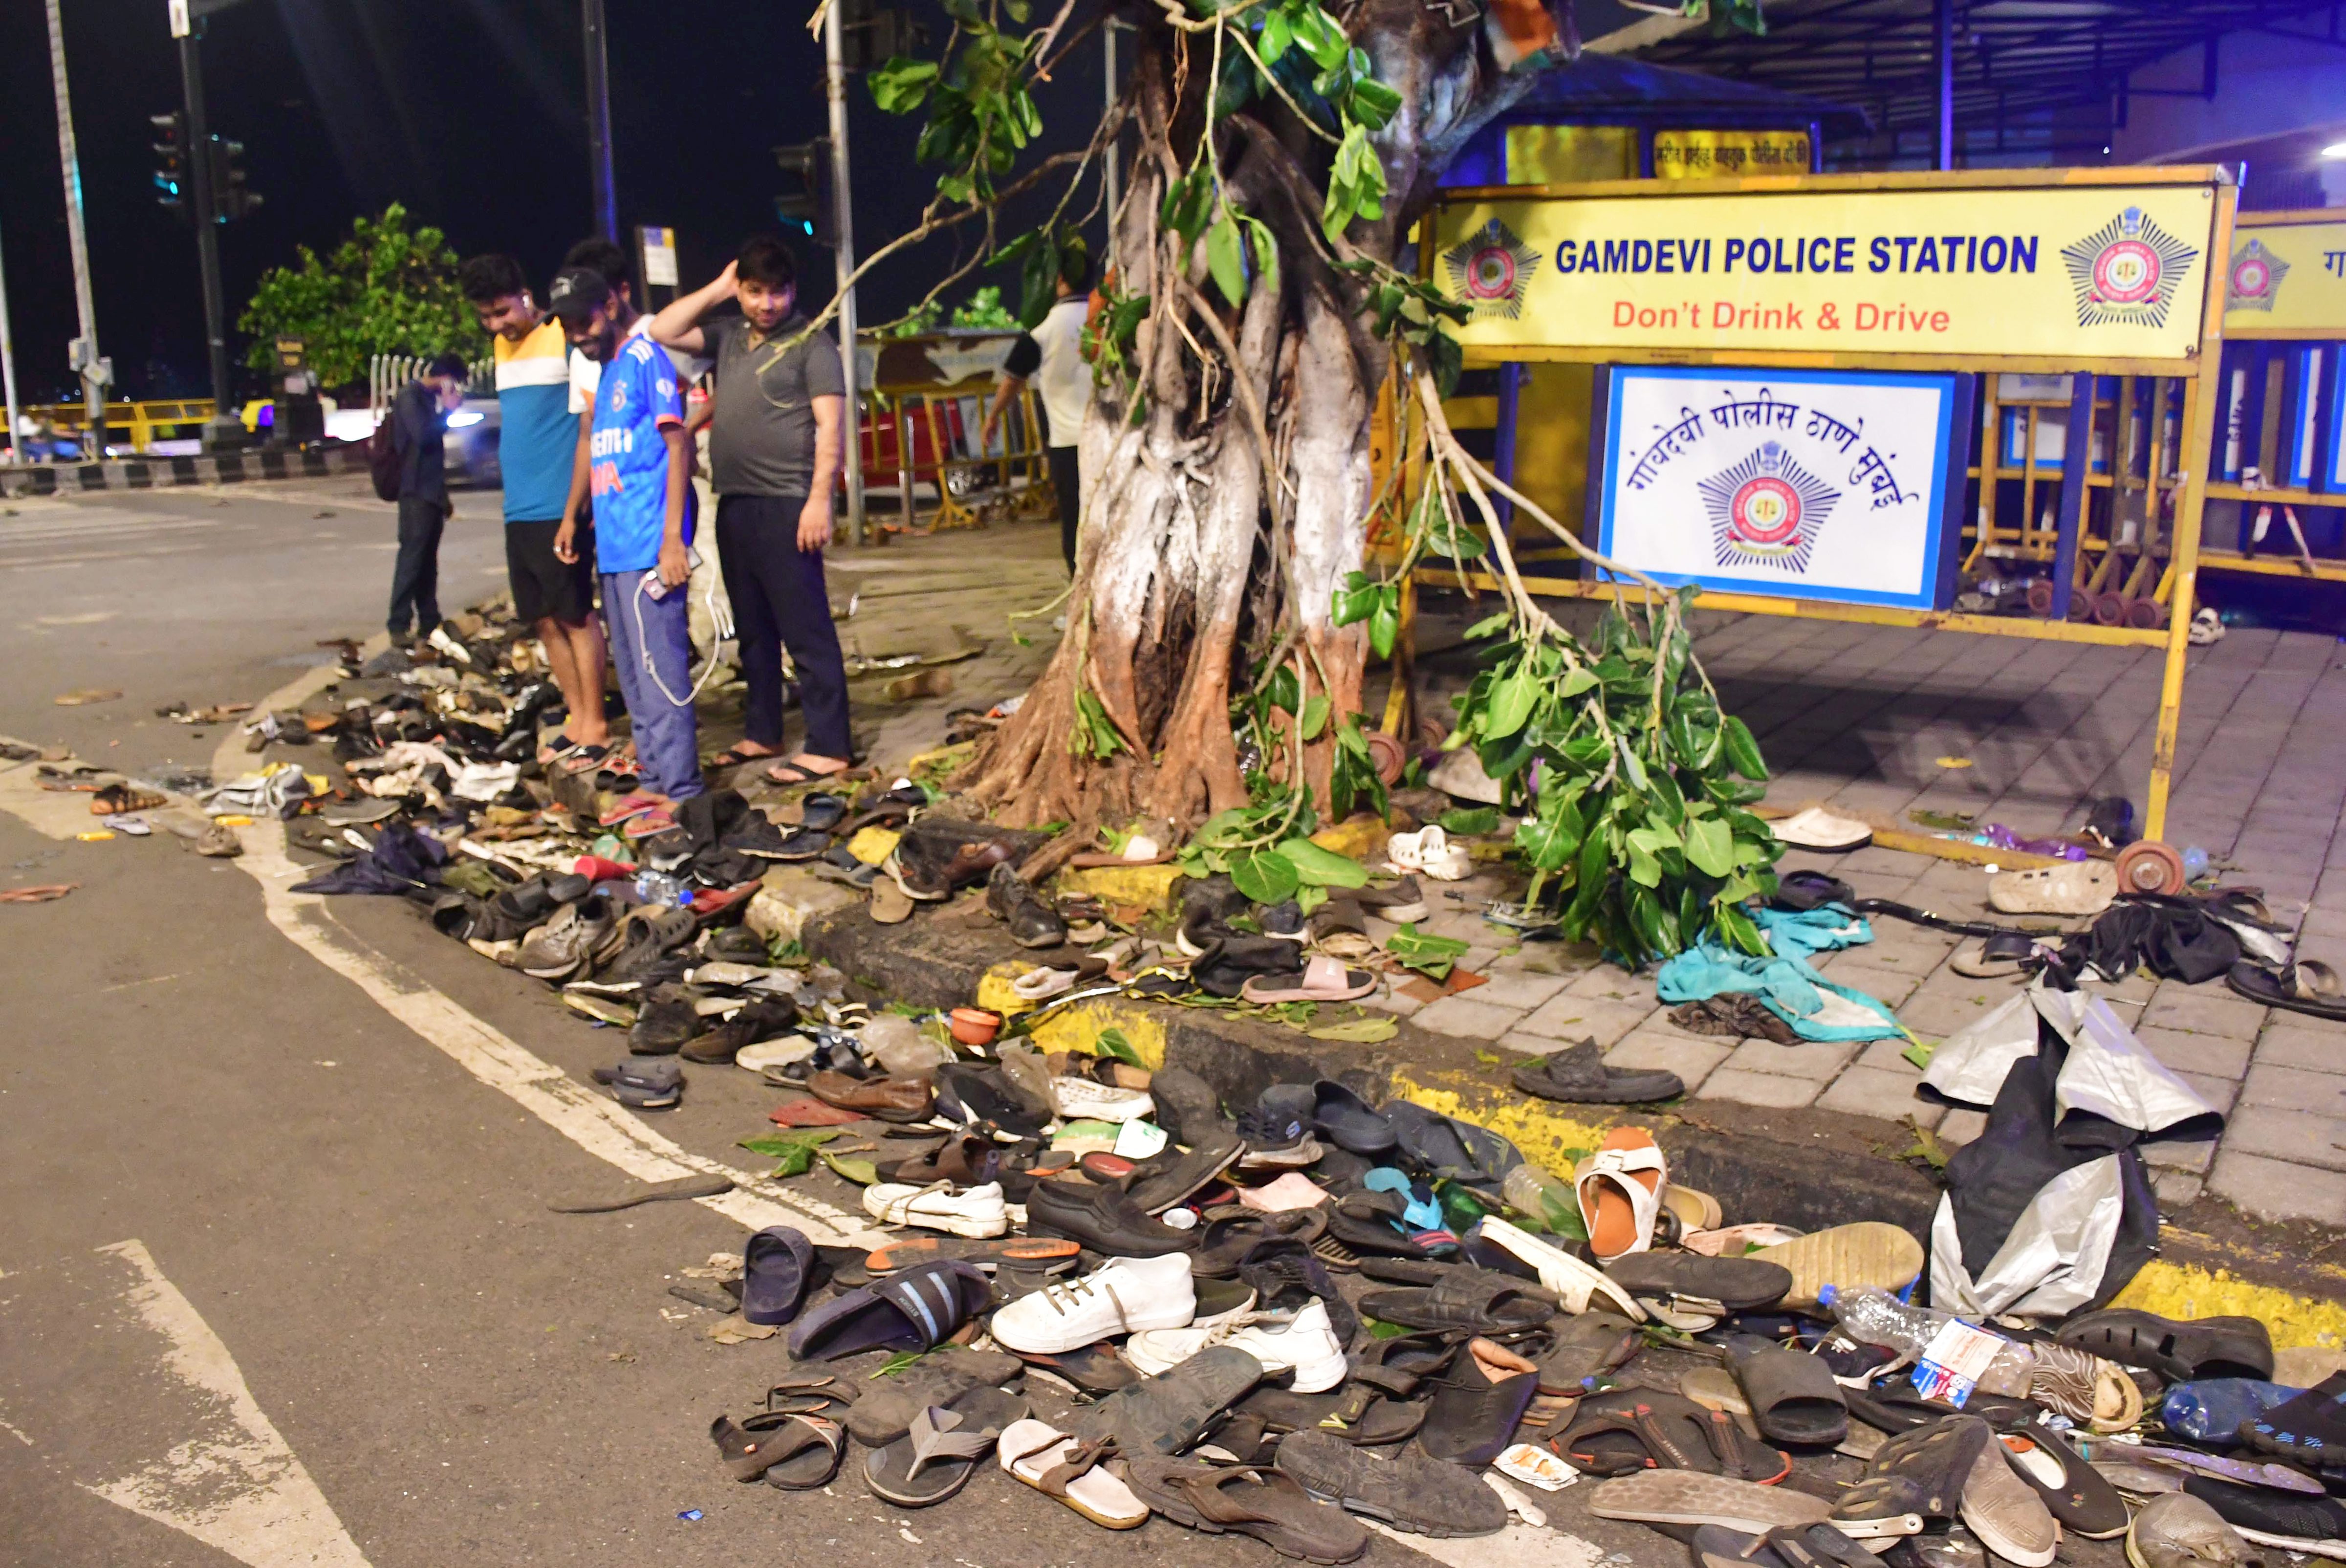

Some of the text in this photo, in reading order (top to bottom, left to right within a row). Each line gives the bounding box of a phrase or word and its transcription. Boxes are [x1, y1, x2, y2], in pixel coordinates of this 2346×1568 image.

[1556, 236, 2039, 274] GAMDEVI POLICE STATION
[1713, 301, 1803, 330] Drink
[1816, 302, 1841, 331] &
[1855, 302, 1951, 333] Drive
[1627, 406, 1706, 490] गांवदेवी
[1710, 387, 1800, 430] पोलीस
[1806, 410, 1864, 454] ठाणे
[1848, 447, 1920, 511] मुंबई
